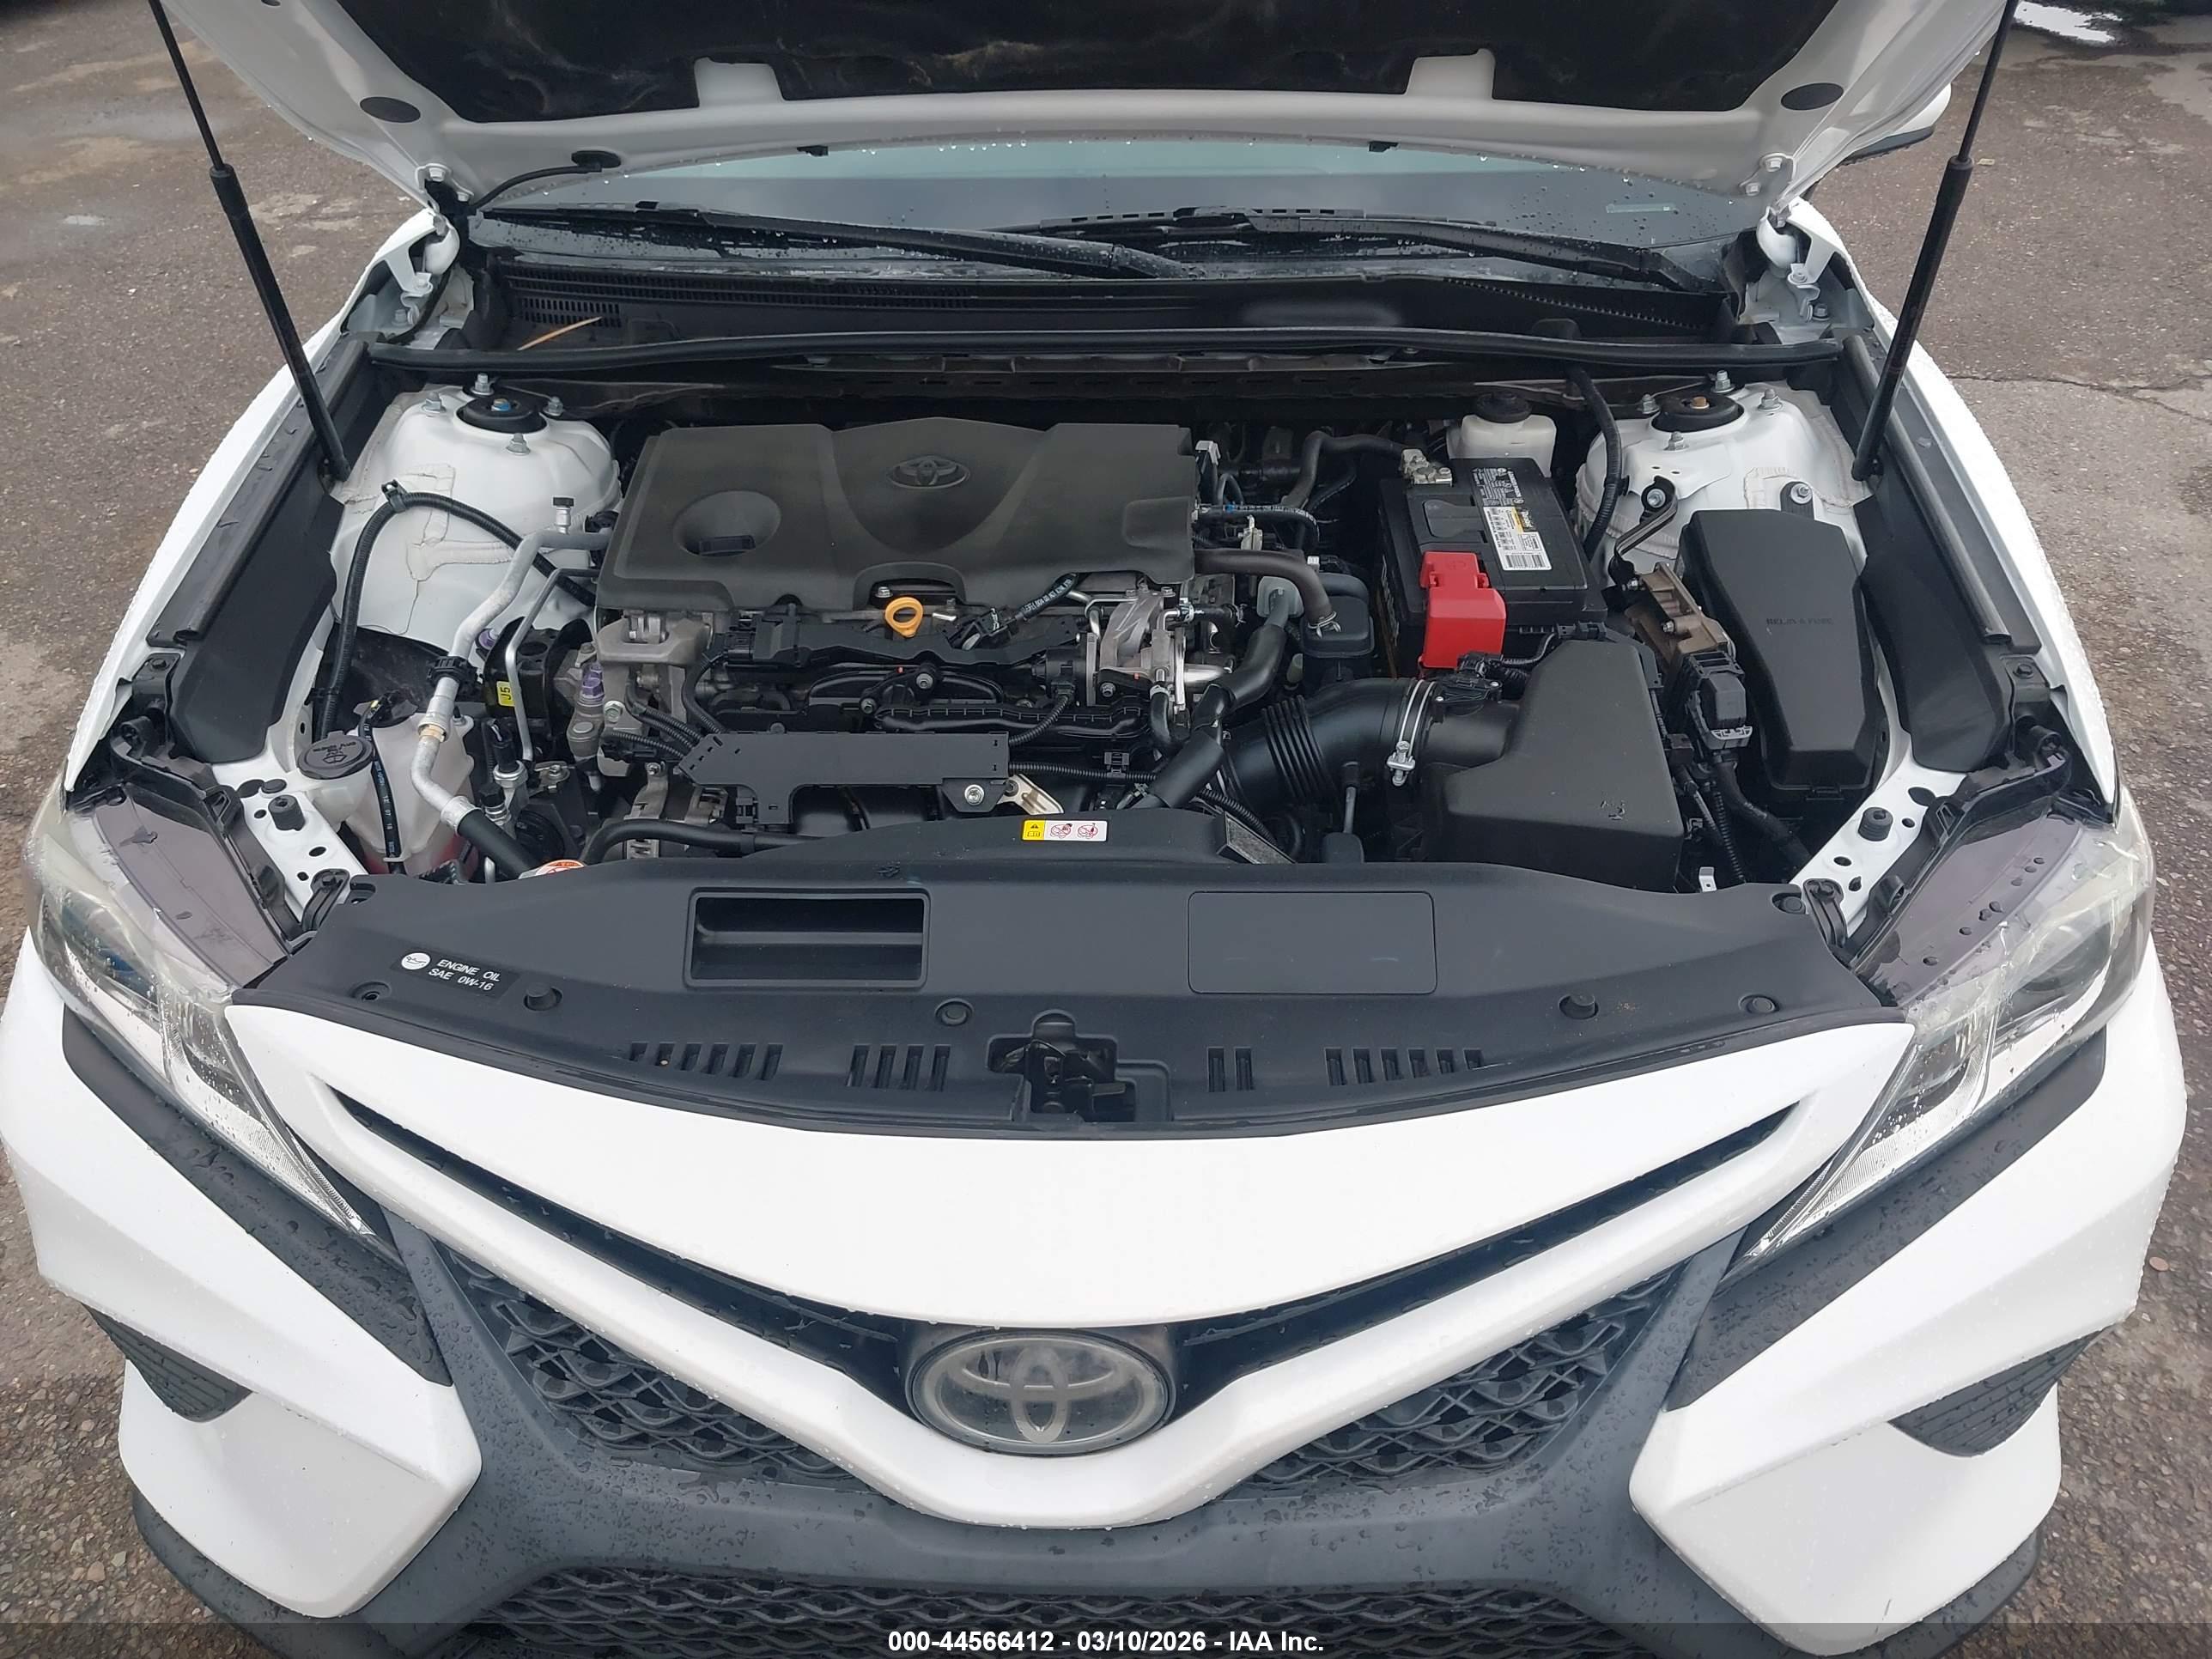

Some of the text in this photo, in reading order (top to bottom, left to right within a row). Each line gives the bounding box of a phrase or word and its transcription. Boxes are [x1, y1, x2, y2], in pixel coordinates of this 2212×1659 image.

[500, 687, 512, 701] J5
[428, 968, 495, 991] SAE 0W-16
[436, 959, 501, 981] ENGINE OIL
